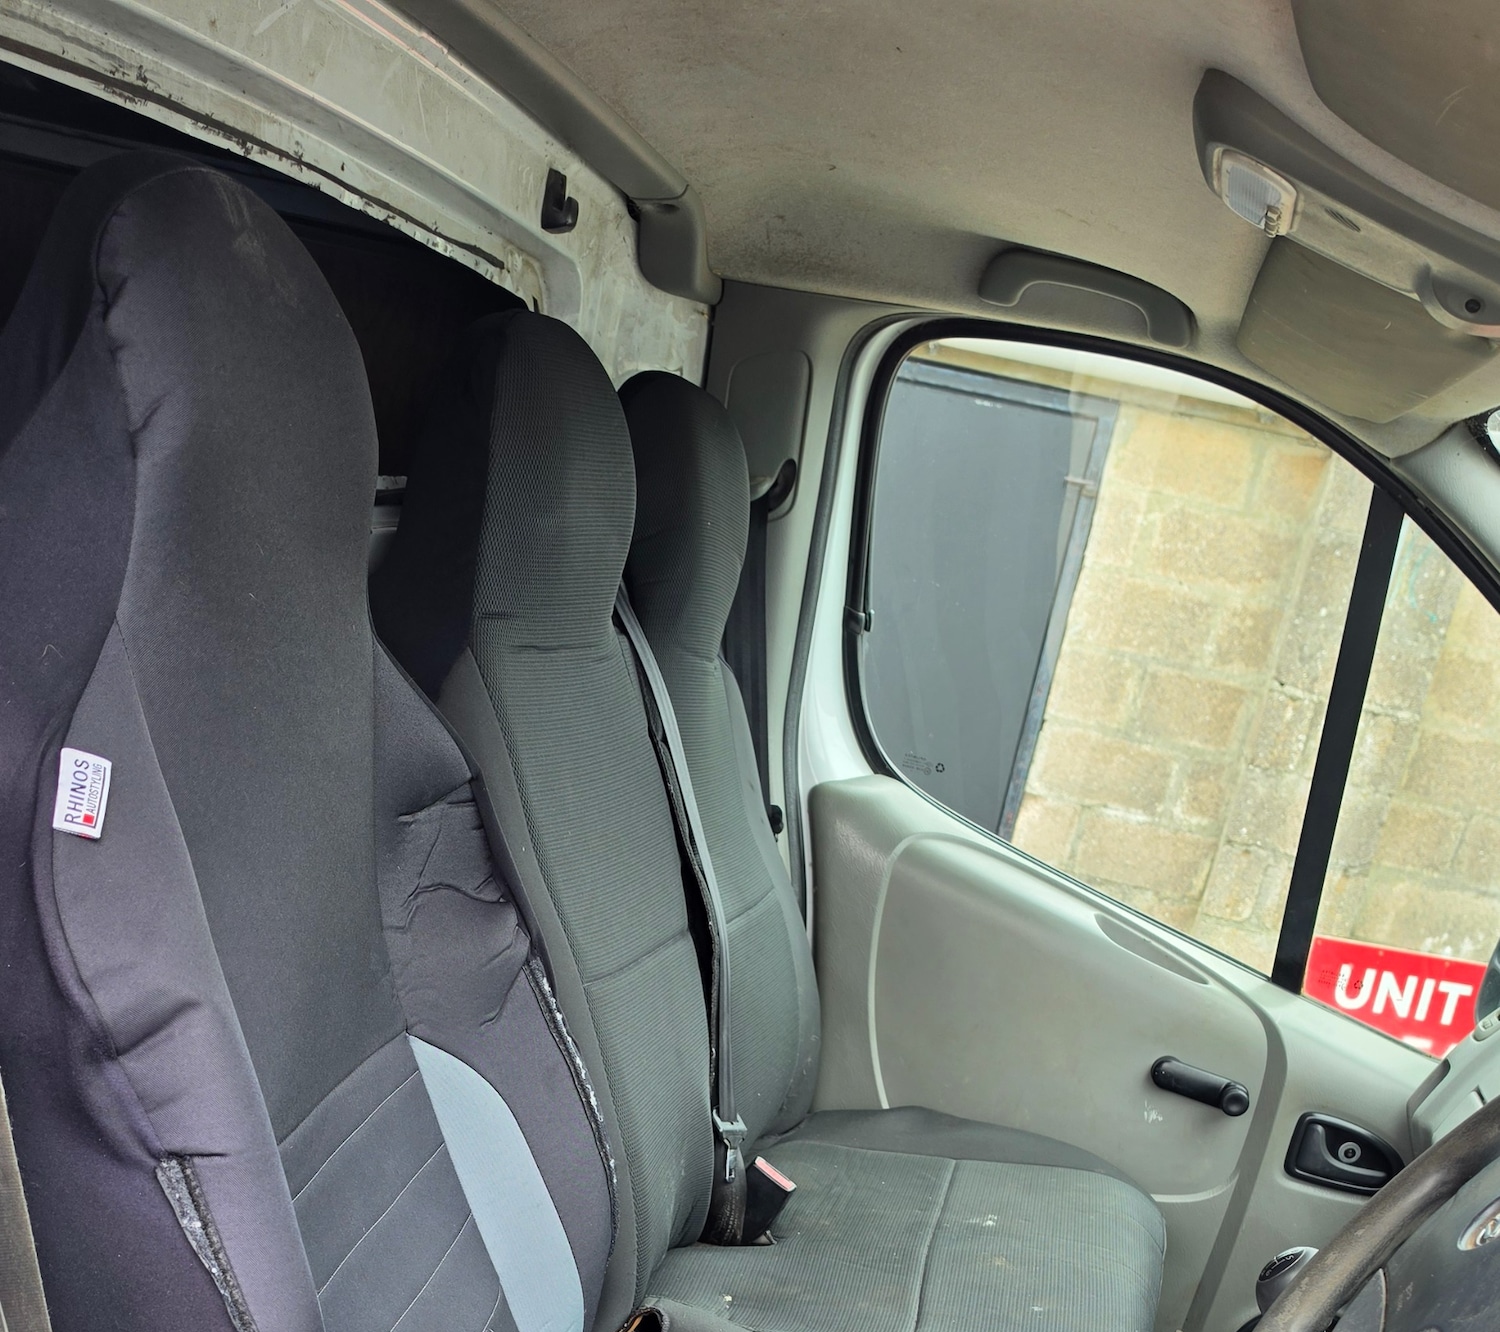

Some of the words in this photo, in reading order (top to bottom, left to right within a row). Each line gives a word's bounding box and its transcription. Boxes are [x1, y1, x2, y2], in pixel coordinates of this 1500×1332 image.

[64, 759, 90, 824] RHINOS
[86, 763, 102, 814] AUTOSTYLING
[1334, 963, 1474, 1026] UNIT
